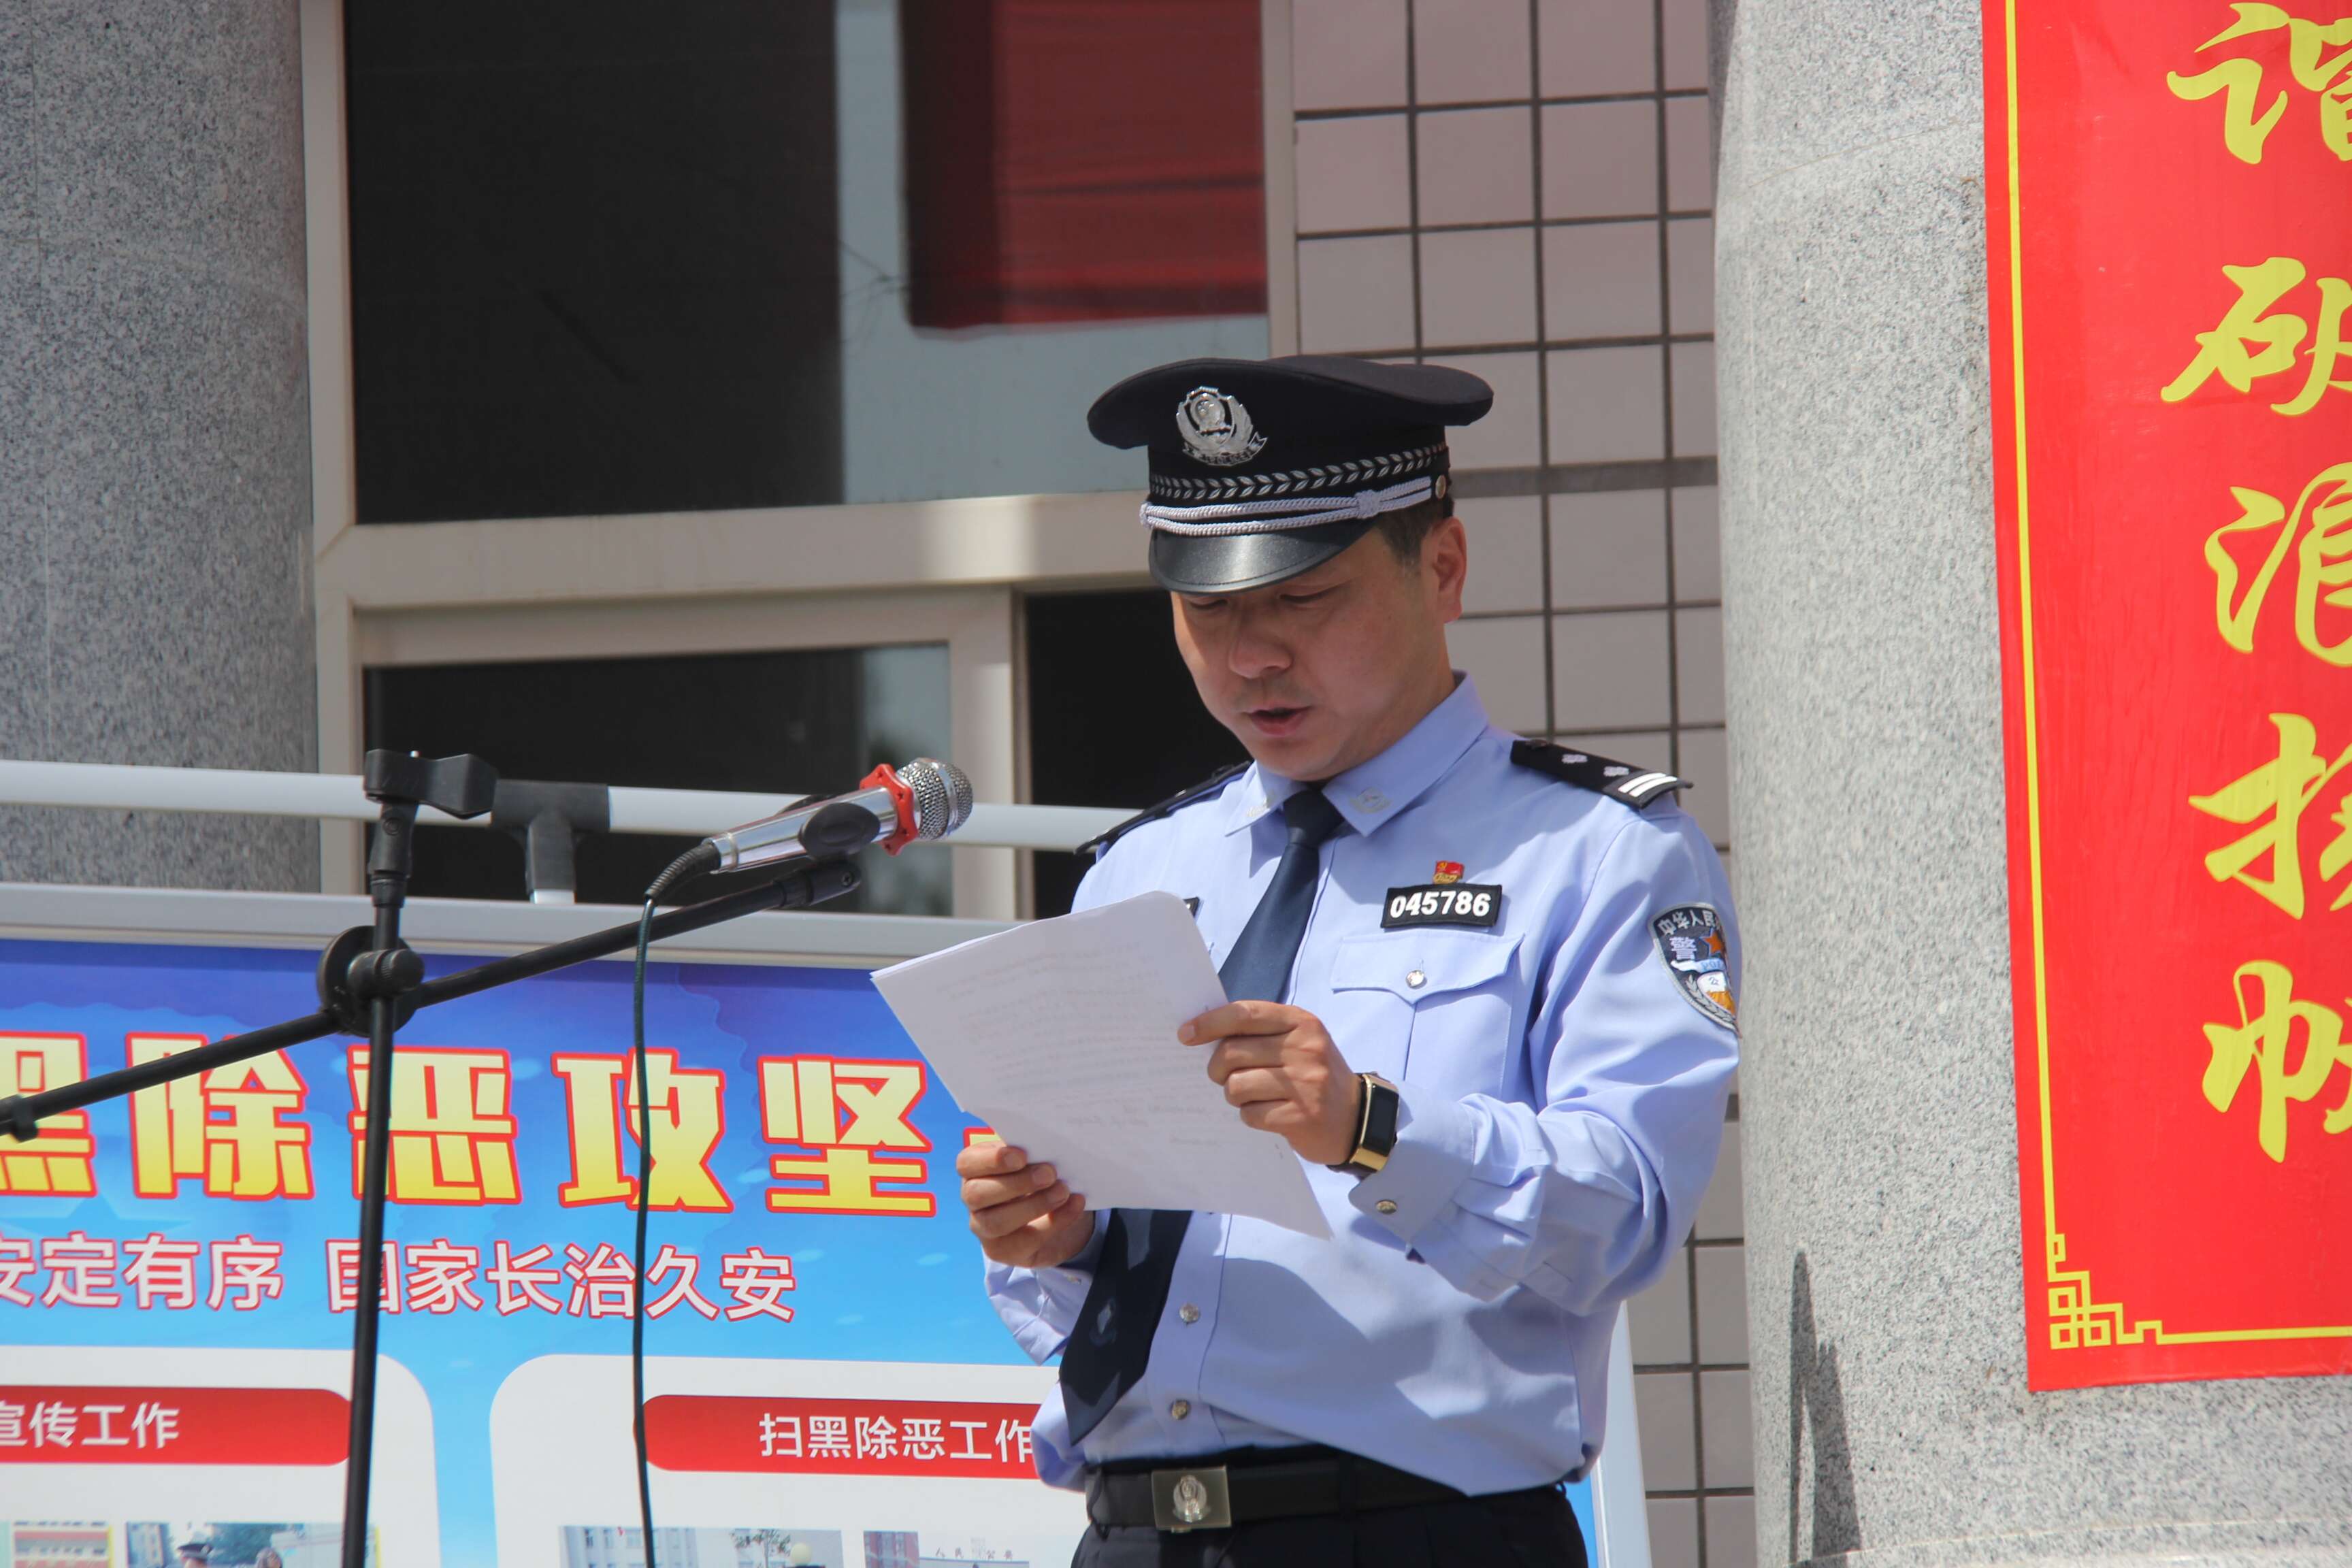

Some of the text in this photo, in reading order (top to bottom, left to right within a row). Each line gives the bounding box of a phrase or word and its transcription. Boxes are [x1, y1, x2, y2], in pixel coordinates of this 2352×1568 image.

[1390, 890, 1491, 918] 045786
[0, 1031, 1007, 1218] 黑除恶攻坚
[326, 1239, 797, 1322] 国家长治久安
[0, 1400, 180, 1449] 宣传工作
[759, 1413, 1034, 1463] 扫黑除恶工作
